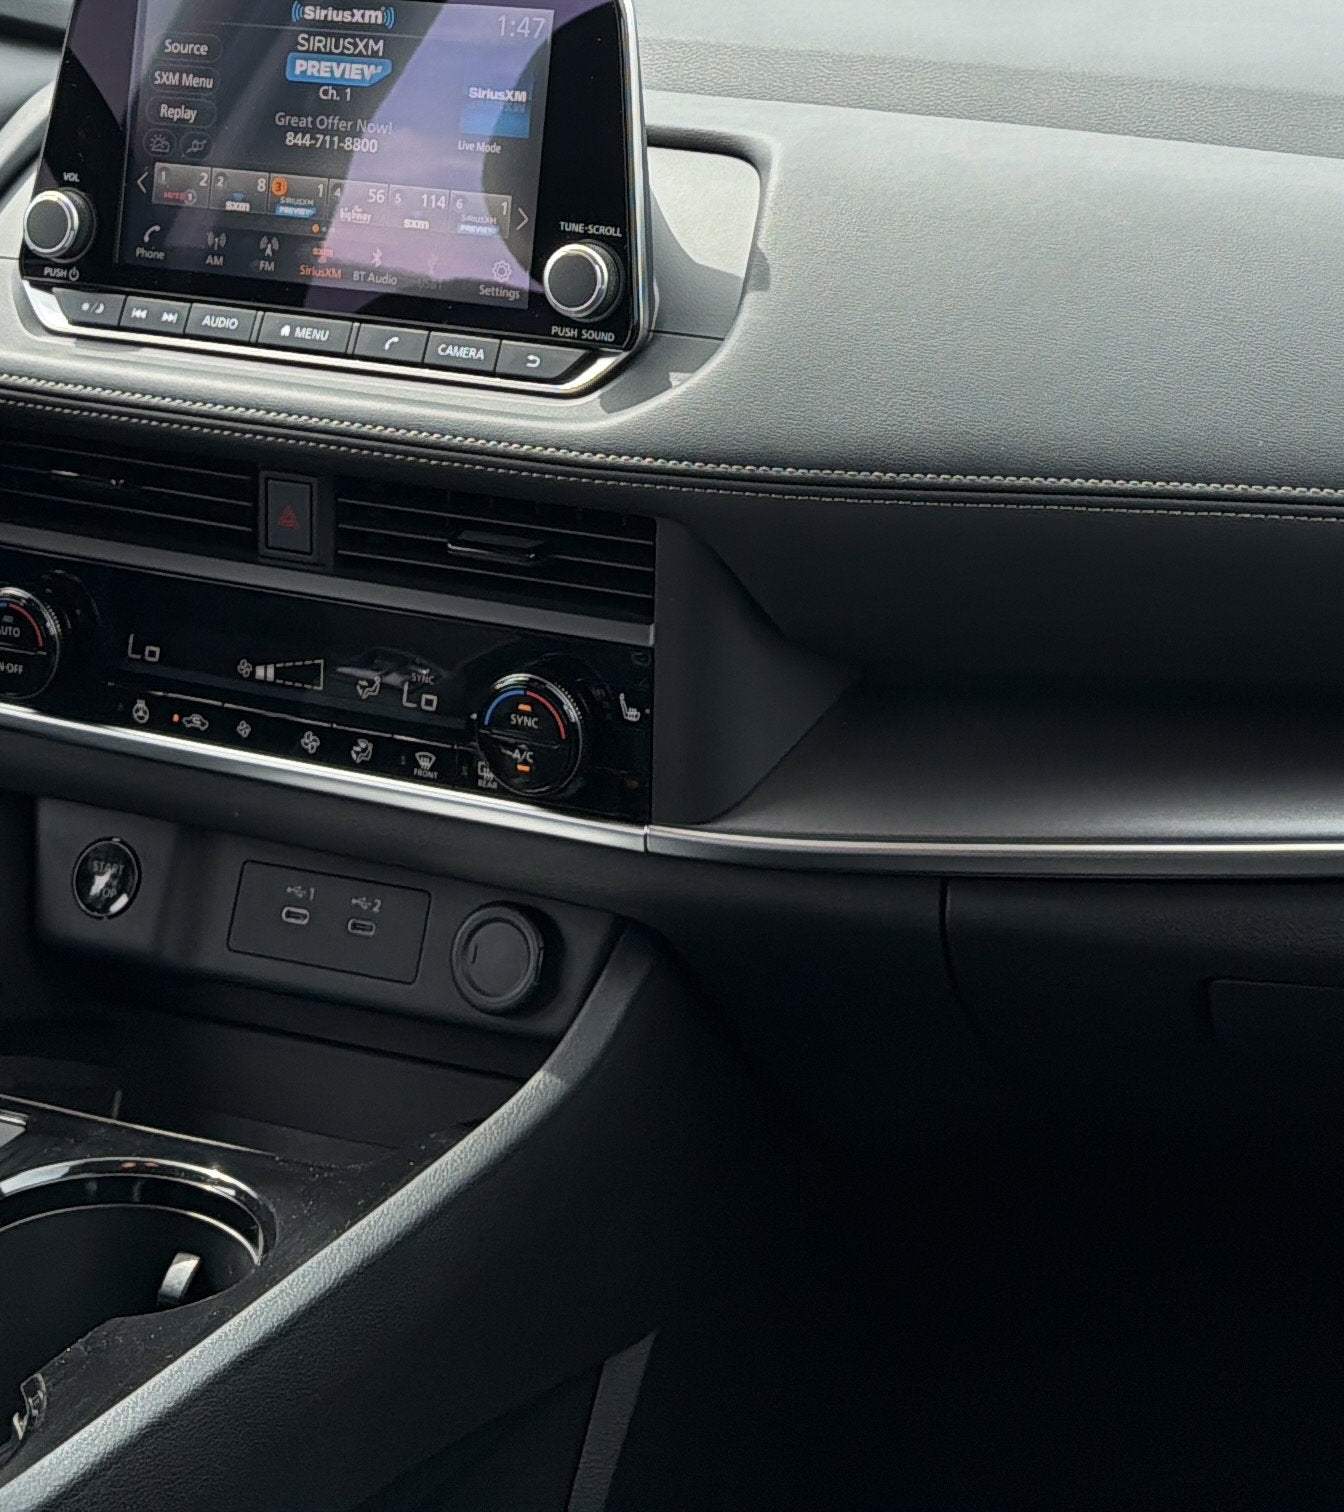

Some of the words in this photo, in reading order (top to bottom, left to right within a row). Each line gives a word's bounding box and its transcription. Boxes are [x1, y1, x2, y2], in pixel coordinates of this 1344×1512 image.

[498, 15, 546, 38] 1:47
[164, 39, 209, 56] Source
[297, 33, 384, 57] SIRIUSXM
[154, 71, 180, 86] SXM
[181, 73, 213, 89] Menu
[319, 86, 340, 100] Ch.
[345, 88, 351, 101] 1
[468, 87, 527, 103] SiriusXM
[160, 104, 197, 123] Replay
[275, 113, 312, 129] Great
[316, 115, 352, 132] Offer
[357, 119, 394, 136] Now!
[285, 132, 378, 153] 844-711-8800
[457, 140, 475, 151] Live
[477, 141, 502, 154] Mode
[63, 172, 80, 183] VOL
[199, 172, 208, 187] 2
[257, 177, 267, 193] 8
[317, 184, 324, 198] 1
[368, 189, 385, 203] 56
[421, 194, 446, 209] 114
[456, 198, 463, 210] 6
[501, 201, 507, 216] 1
[135, 246, 166, 260] Phone
[206, 255, 224, 266] AM
[43, 266, 68, 279] PUSH
[259, 260, 275, 272] FM
[299, 264, 342, 280] SiriusXM
[353, 271, 366, 282] BT
[367, 272, 398, 286] Audio
[479, 284, 521, 301] Settings
[202, 314, 239, 330] AUDIO
[294, 327, 329, 341] MENU
[551, 325, 578, 338] PUSH
[581, 328, 615, 342] SOUND
[437, 343, 485, 361] CAMERA
[128, 633, 160, 662] Lo
[411, 671, 434, 686] SYNC
[402, 681, 438, 712] Lo
[510, 713, 539, 729] SYNC
[513, 748, 533, 763] A/C
[413, 767, 438, 779] FRONT
[478, 778, 497, 789] REAR
[93, 860, 125, 874] START
